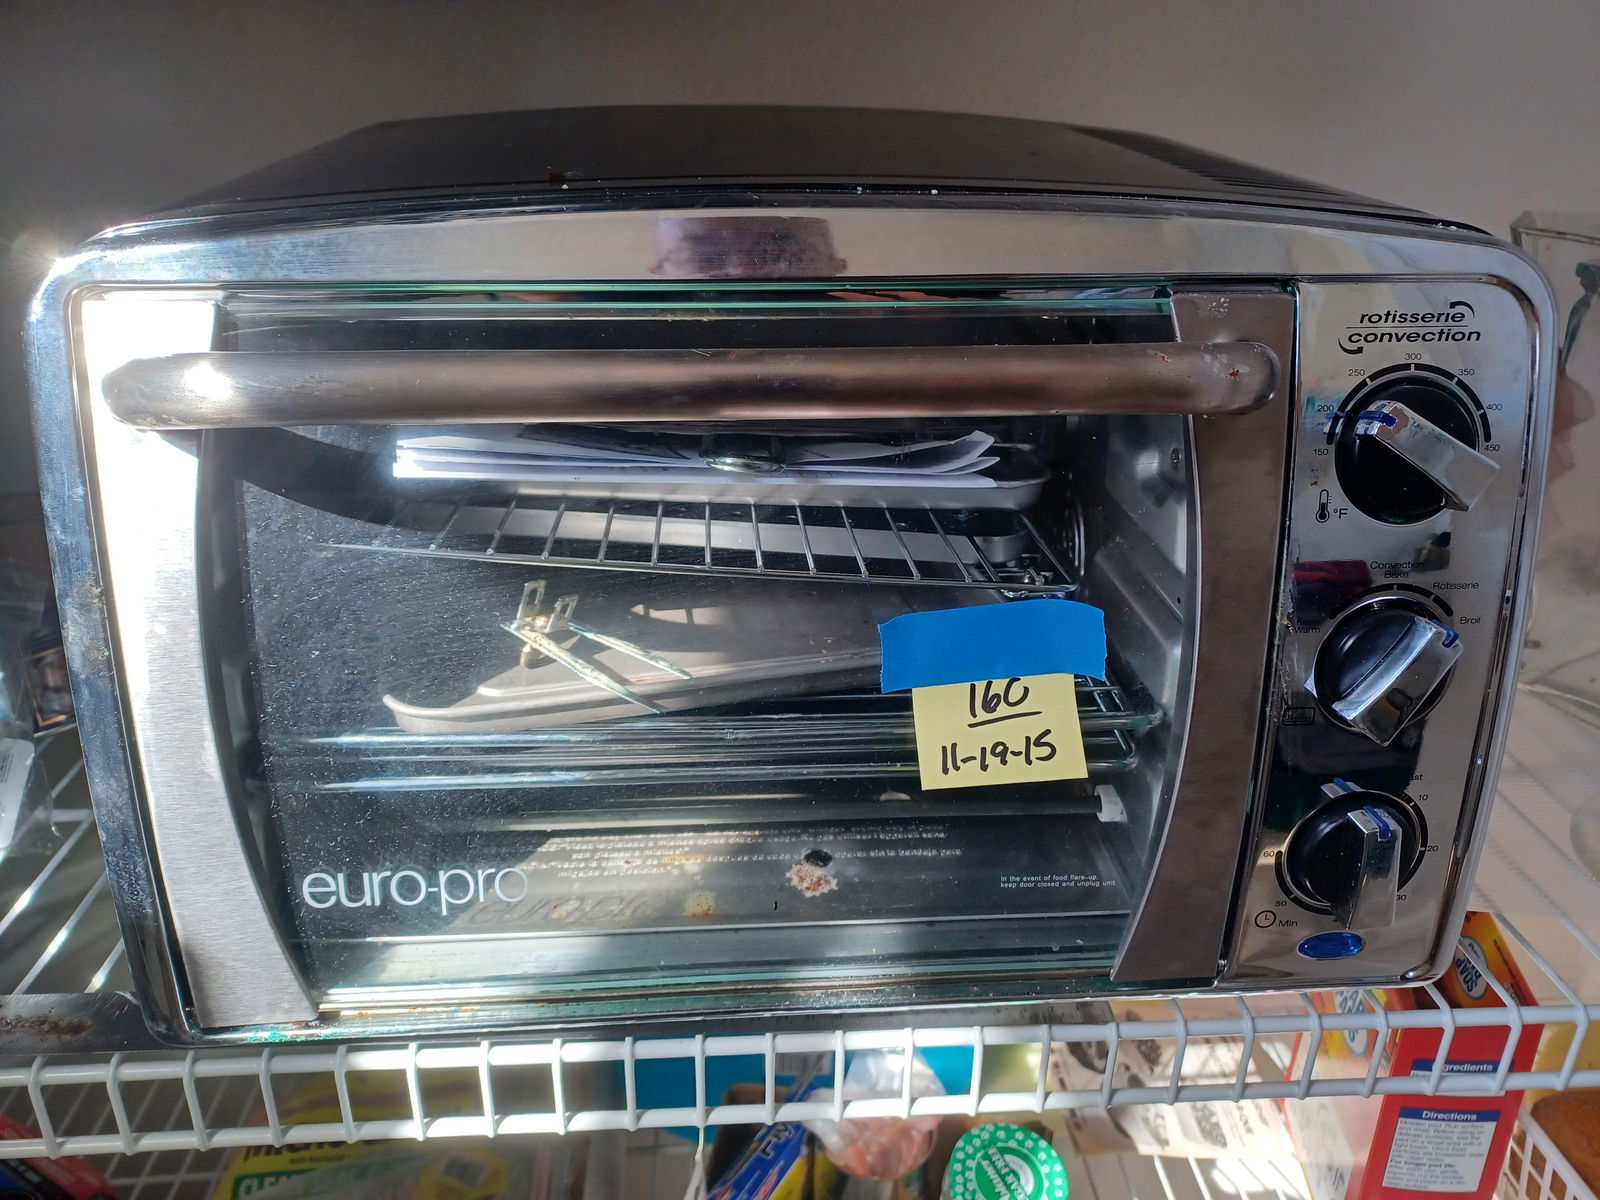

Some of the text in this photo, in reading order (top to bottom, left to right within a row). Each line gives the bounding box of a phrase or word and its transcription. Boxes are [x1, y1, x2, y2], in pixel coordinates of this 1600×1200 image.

[1359, 310, 1466, 324] rotisserie
[1347, 329, 1481, 343] convection
[1405, 352, 1422, 360] 300
[1348, 369, 1365, 377] 250
[1458, 368, 1475, 376] 350
[1317, 404, 1334, 412] 200
[1486, 403, 1502, 411] 400
[1313, 448, 1328, 456] 150
[1484, 444, 1500, 452] 450
[1370, 560, 1425, 570] Convection
[1384, 570, 1409, 579] Bake
[1433, 581, 1479, 591] Rotisserie
[1460, 616, 1481, 625] Broil
[941, 729, 1058, 775] 11-19-15
[1263, 850, 1275, 858] 60
[302, 867, 528, 916] euro-pro
[1278, 919, 1298, 927] Min
[1455, 958, 1475, 993] SOAP
[1442, 1062, 1493, 1073] gredients
[1422, 1110, 1477, 1121] Directions
